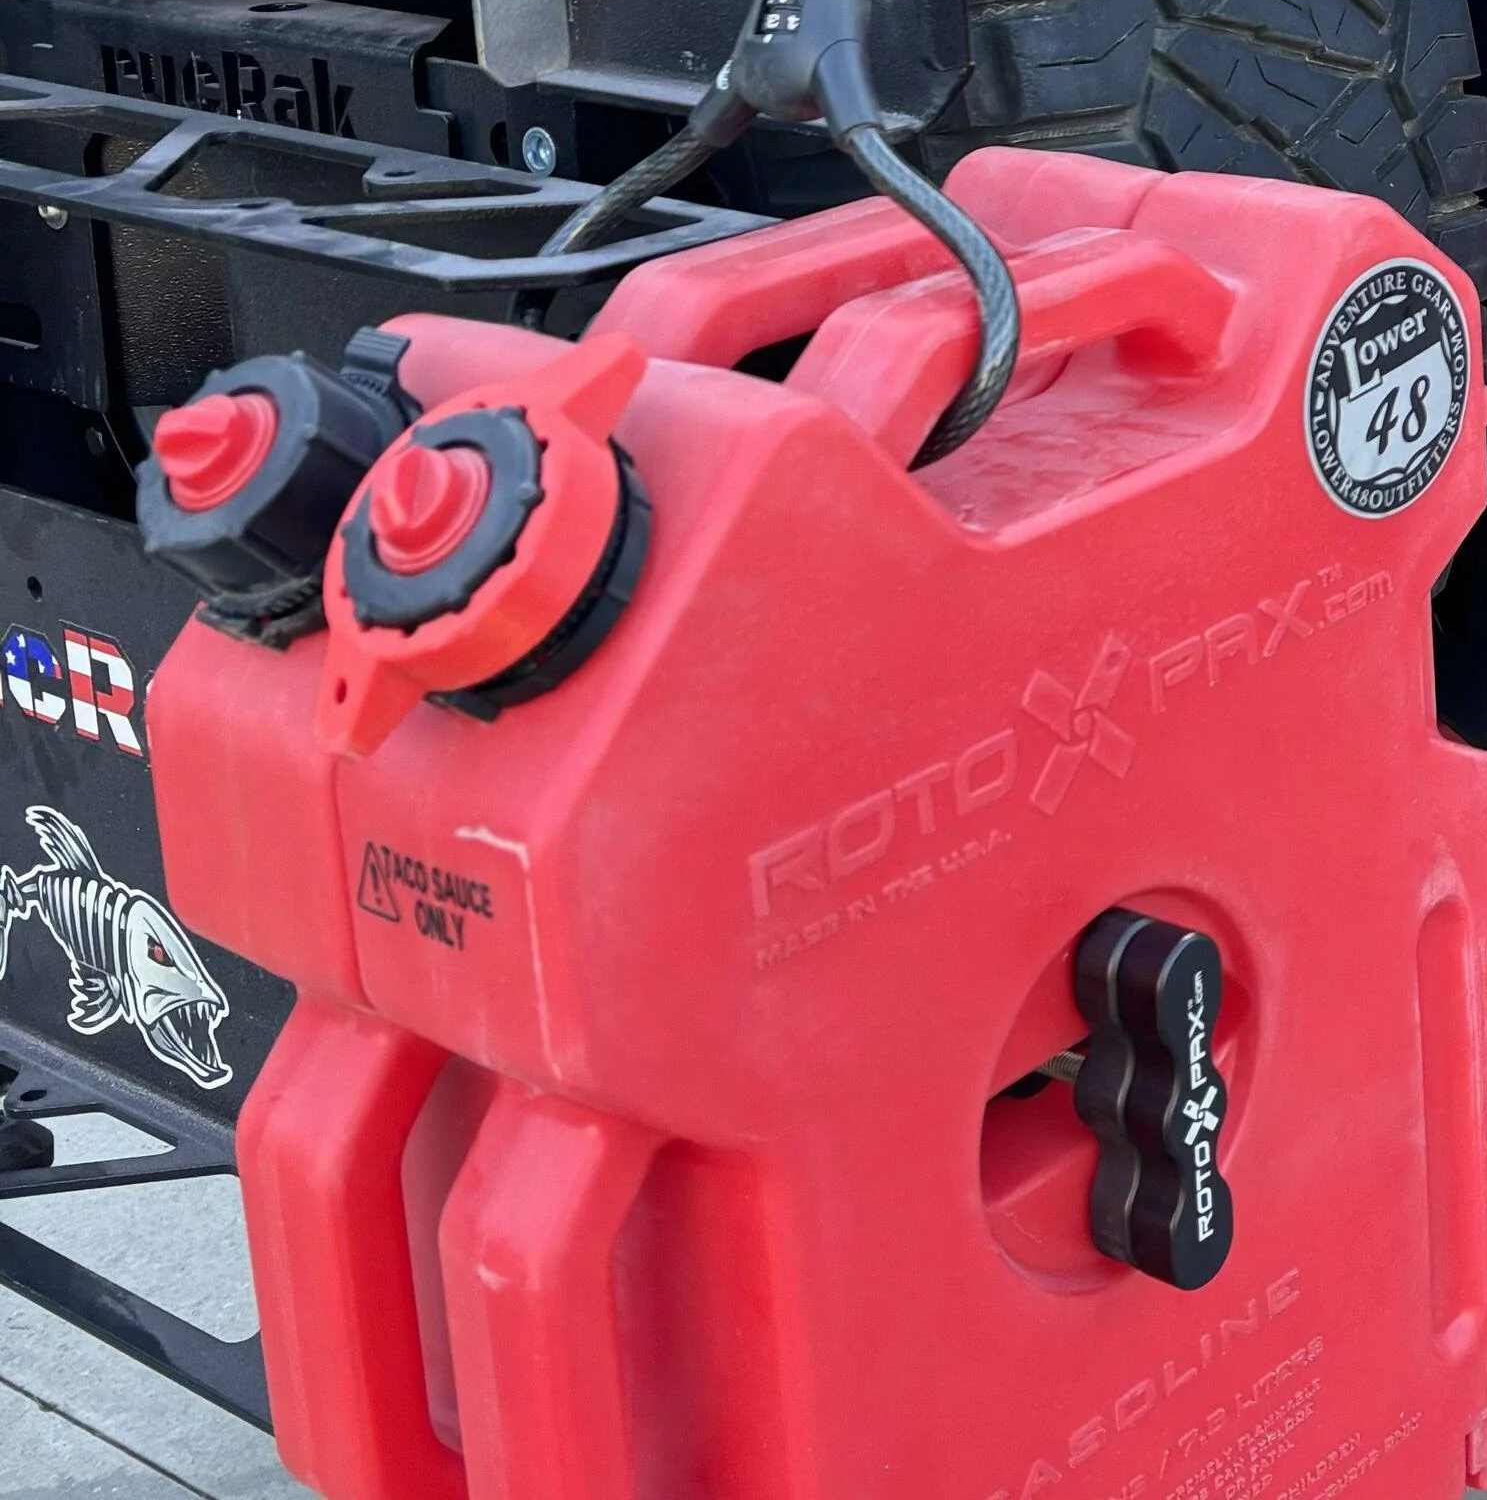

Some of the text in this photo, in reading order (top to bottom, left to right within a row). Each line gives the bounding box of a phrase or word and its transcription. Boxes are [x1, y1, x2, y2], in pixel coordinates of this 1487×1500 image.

[1314, 271, 1451, 388] ADVENTURE GEAR
[1340, 307, 1429, 403] Lower
[1312, 332, 1466, 510] LOWER48OUTFITTERS.COM
[1365, 374, 1431, 456] 48
[748, 727, 1019, 921] ROTO
[380, 845, 493, 919] TACO SAUCE
[415, 899, 465, 951] ONLY
[1193, 1140, 1214, 1242] ROTO
[984, 1266, 1302, 1500] ASOLINE
